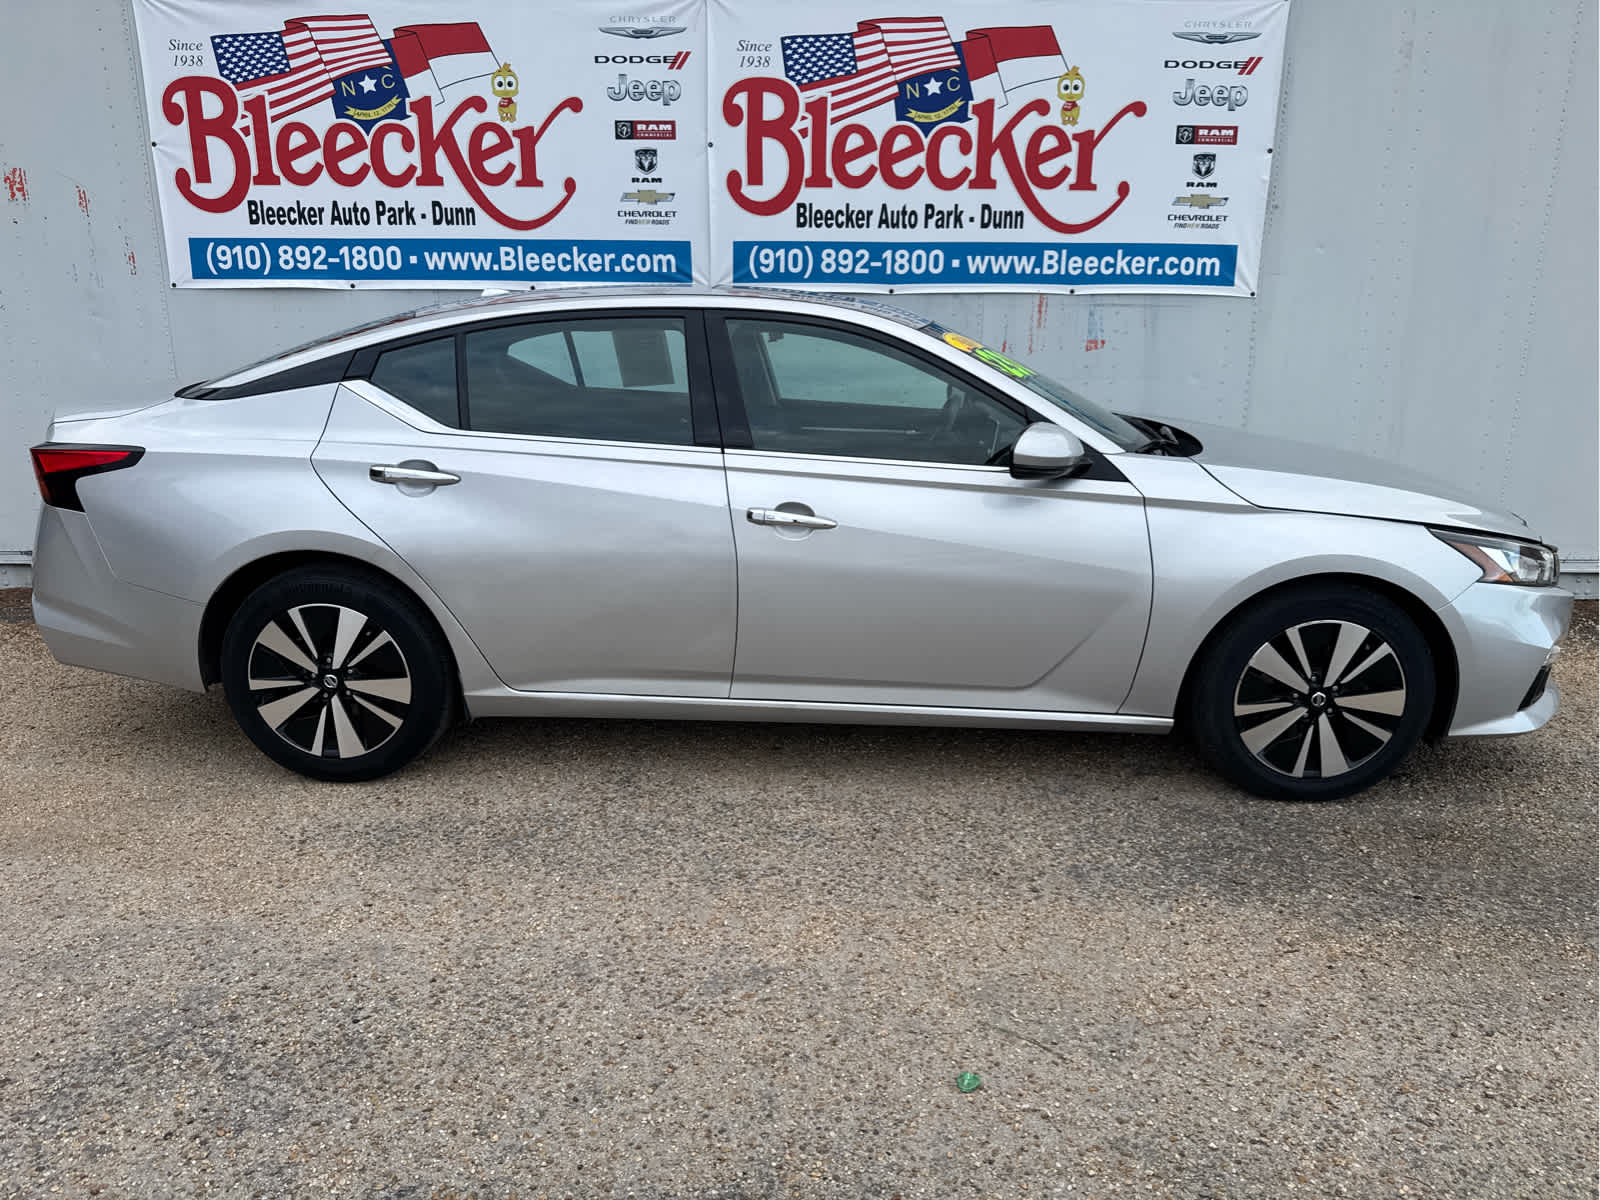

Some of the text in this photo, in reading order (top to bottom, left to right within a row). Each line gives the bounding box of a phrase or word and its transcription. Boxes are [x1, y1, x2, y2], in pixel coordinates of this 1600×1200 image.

[609, 15, 676, 23] CHRYSLER
[1184, 21, 1251, 29] CHRYSLER
[169, 39, 203, 51] Since
[737, 39, 772, 51] Since
[174, 55, 203, 66] 1938
[594, 55, 678, 64] DODGE
[740, 55, 771, 67] 1938
[1164, 60, 1249, 69] DODGE
[341, 74, 395, 96] N C
[607, 73, 681, 106] Jeep
[906, 76, 961, 100] N C
[1173, 78, 1248, 111] Jeep
[162, 75, 584, 231] Bleecker
[722, 76, 1148, 235] Bleecker
[247, 200, 476, 226] Bleecker Auto Park Dunn
[617, 210, 677, 218] CHEVROLET
[796, 202, 1024, 229] Bleecker Auto Park Dunn
[1167, 214, 1228, 222] CHEVROLET
[206, 241, 677, 275] (910) 892-1800 www.Bleecker.com
[749, 245, 1220, 279] (910) 892-1800 www.Bleecker.com
